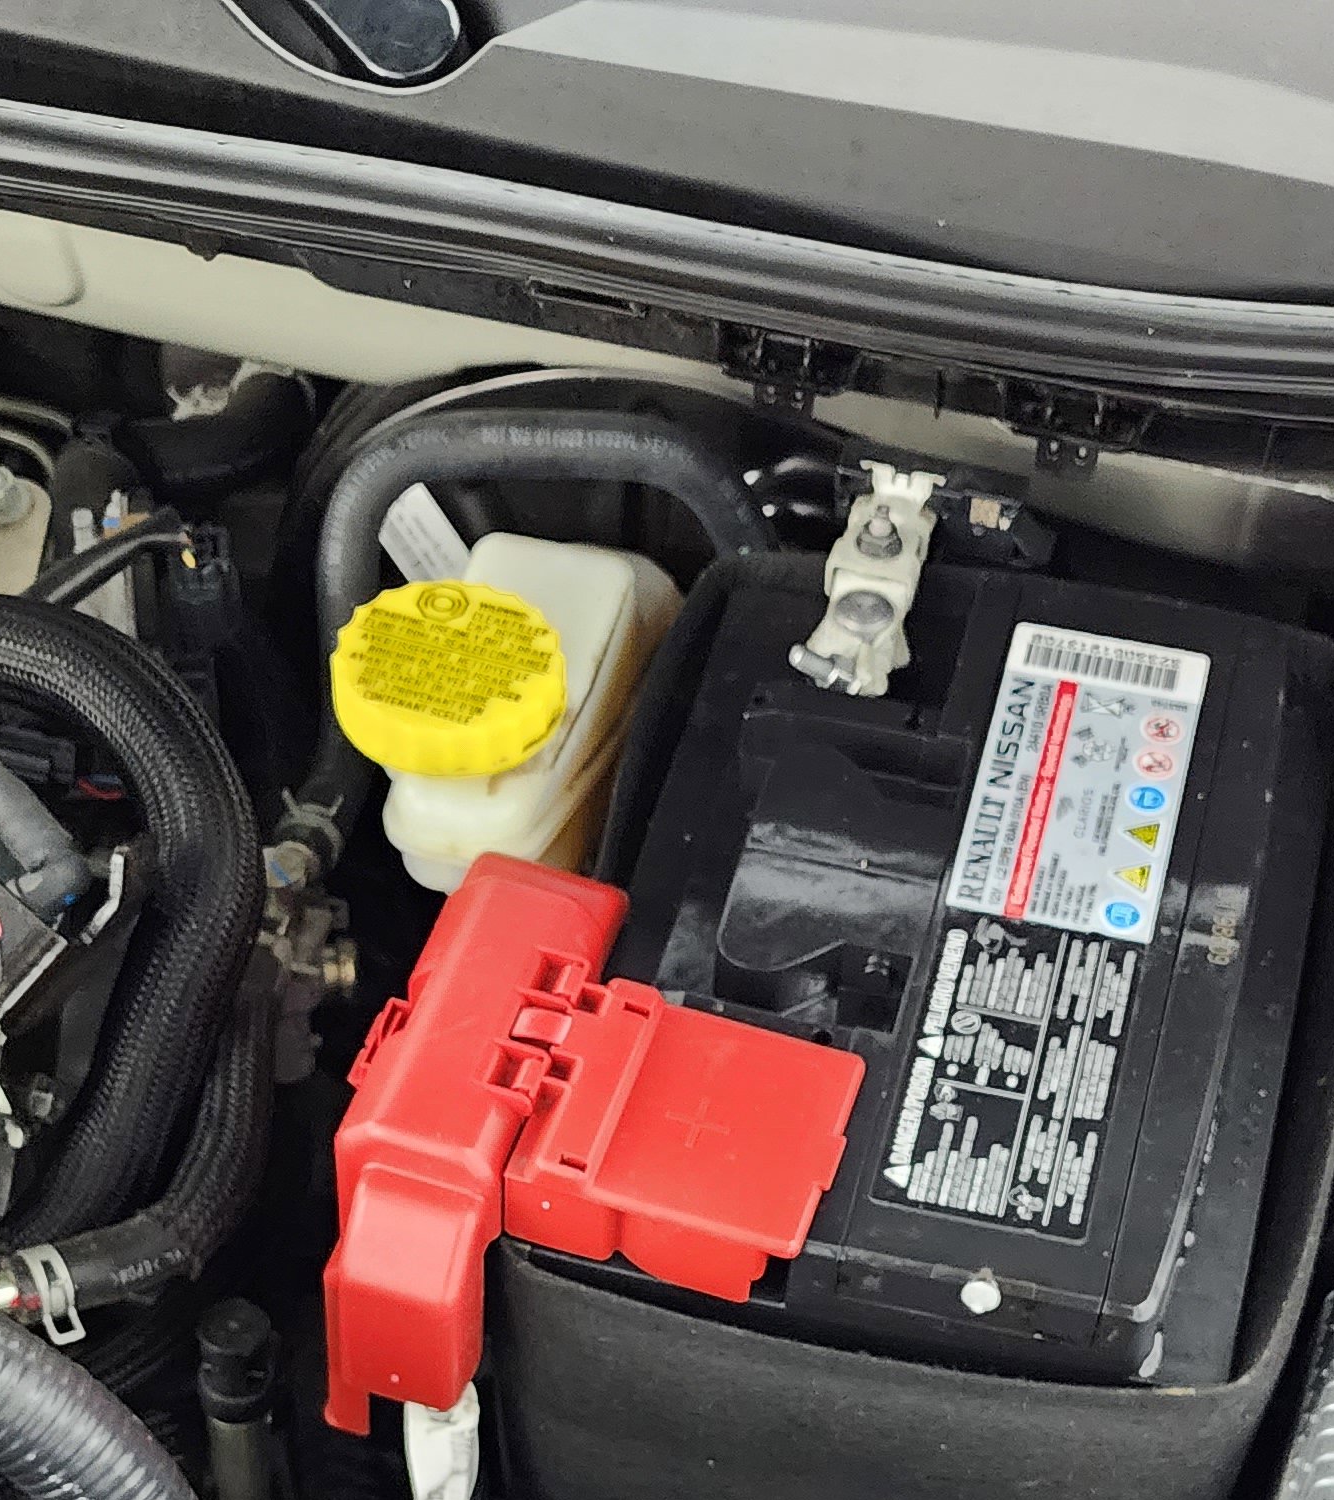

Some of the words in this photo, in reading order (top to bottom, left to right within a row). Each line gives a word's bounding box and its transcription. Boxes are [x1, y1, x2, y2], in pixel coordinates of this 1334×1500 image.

[956, 794, 1006, 903] RENAULT
[986, 675, 1036, 790] NISSAN
[888, 1055, 936, 1167] DANGER/POISON
[922, 926, 970, 1036] PELIGRO/VENENO
